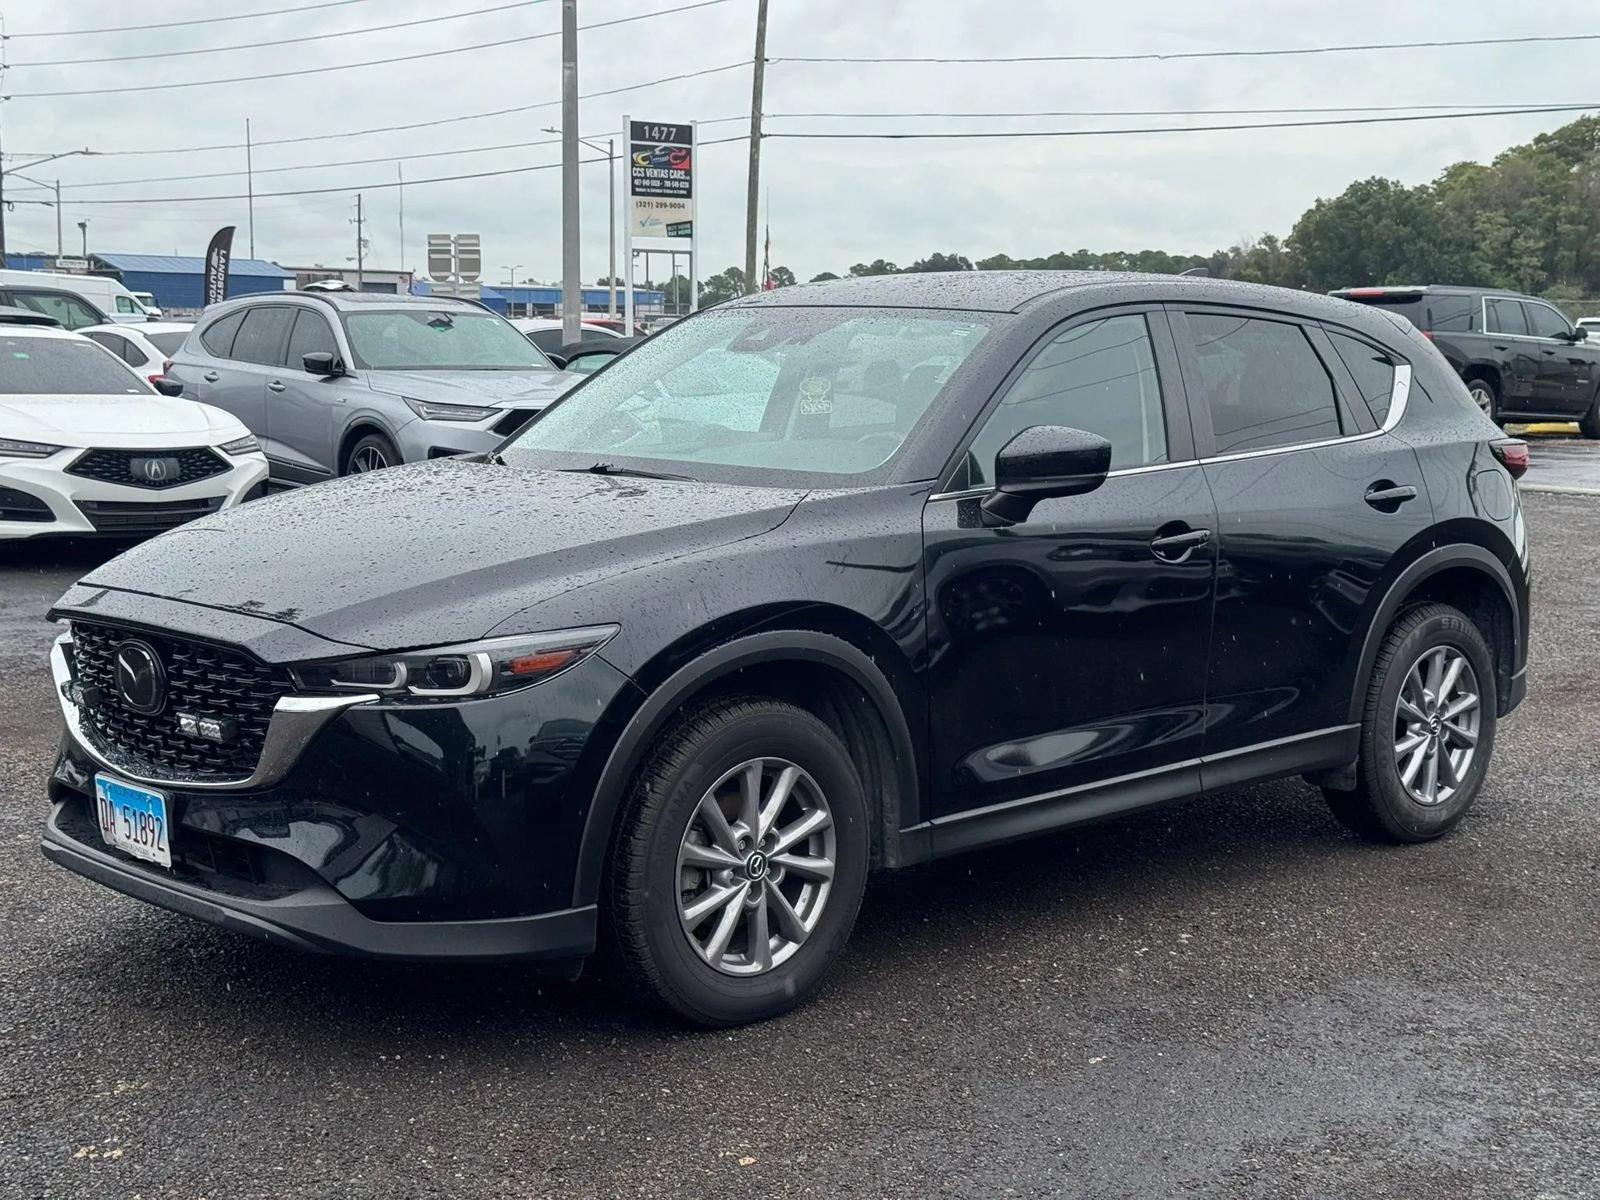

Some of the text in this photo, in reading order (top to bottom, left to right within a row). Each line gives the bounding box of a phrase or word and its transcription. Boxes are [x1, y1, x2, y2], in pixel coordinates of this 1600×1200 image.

[643, 126, 677, 141] 1477
[632, 167, 645, 177] CCS
[645, 168, 669, 179] VENTAS
[635, 200, 654, 209] (321)
[123, 805, 165, 852] 51892
